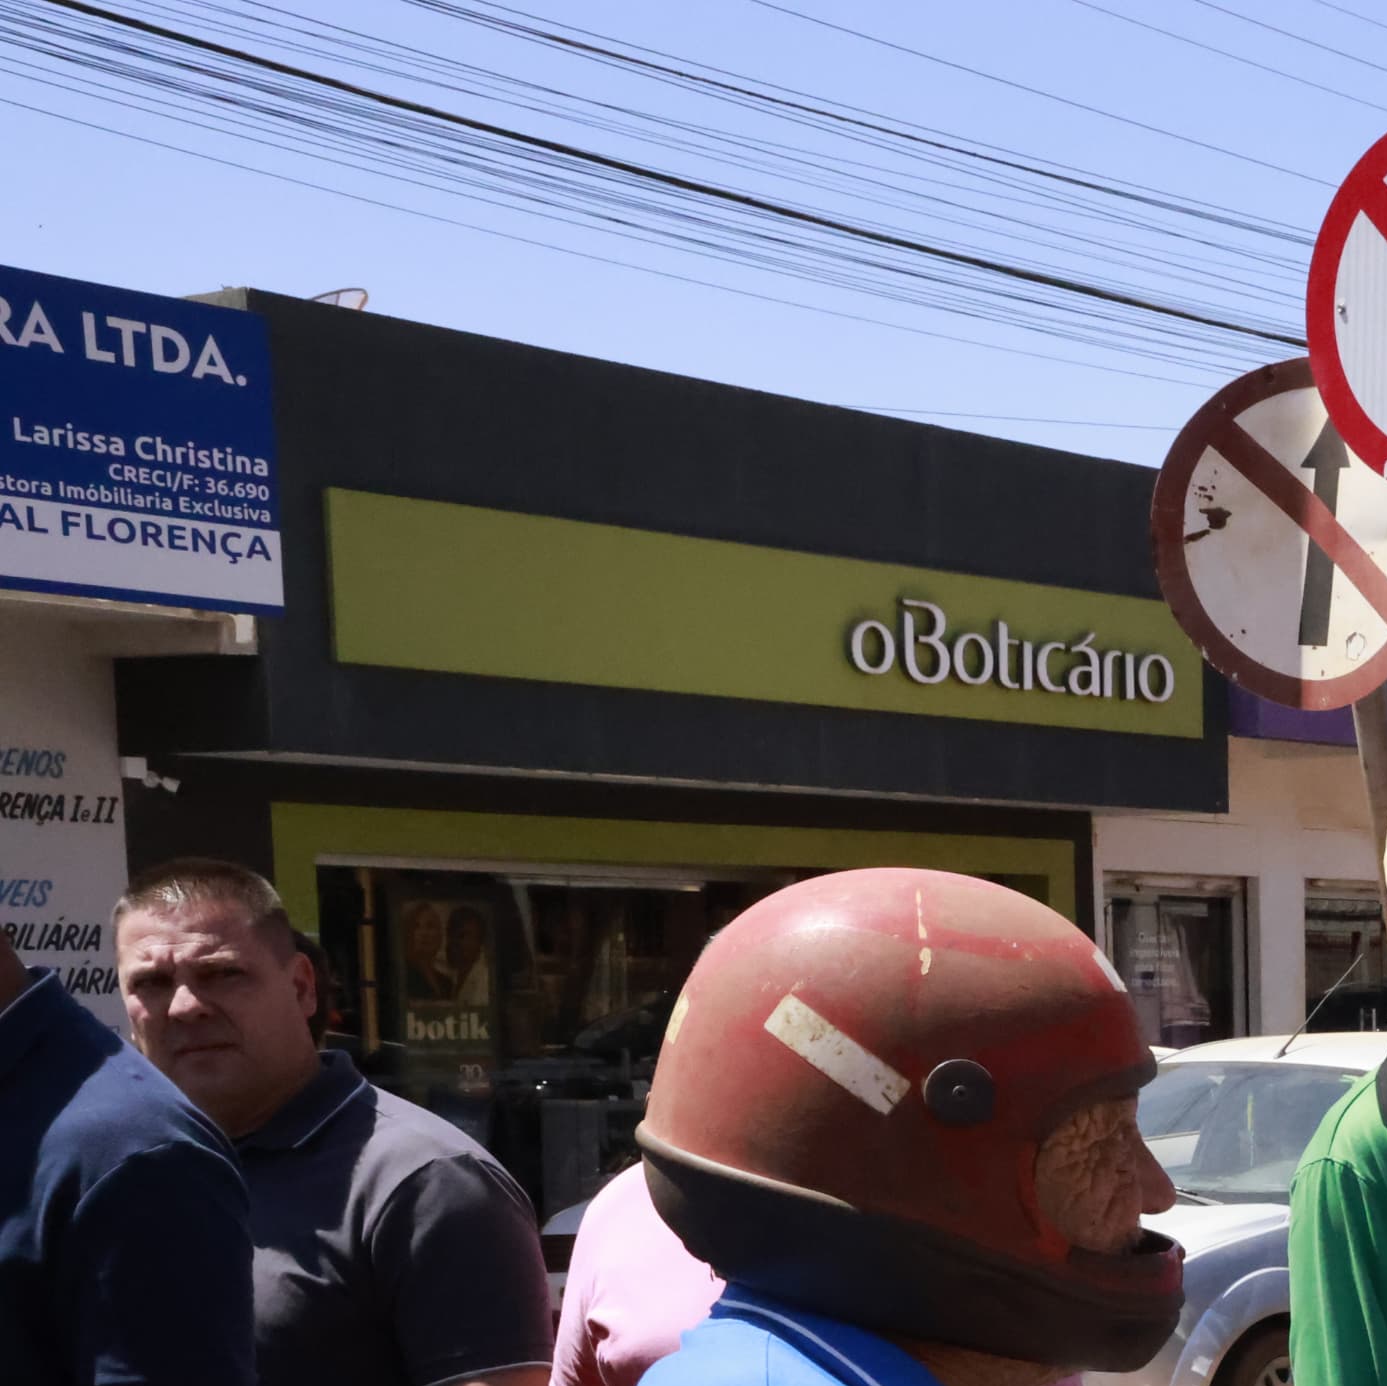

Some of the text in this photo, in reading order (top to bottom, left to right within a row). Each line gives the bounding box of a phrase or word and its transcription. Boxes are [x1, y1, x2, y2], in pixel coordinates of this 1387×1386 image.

[82, 311, 247, 387] LTDA.
[13, 416, 269, 477] Larissa Christina
[58, 481, 173, 511] Imóbiliaria
[179, 496, 271, 523] Exclusiva
[108, 463, 269, 501] CRECI/F: 36.690
[60, 510, 272, 564] FLORENÇA
[0, 747, 66, 779] ENOS
[407, 1011, 490, 1040] botik
